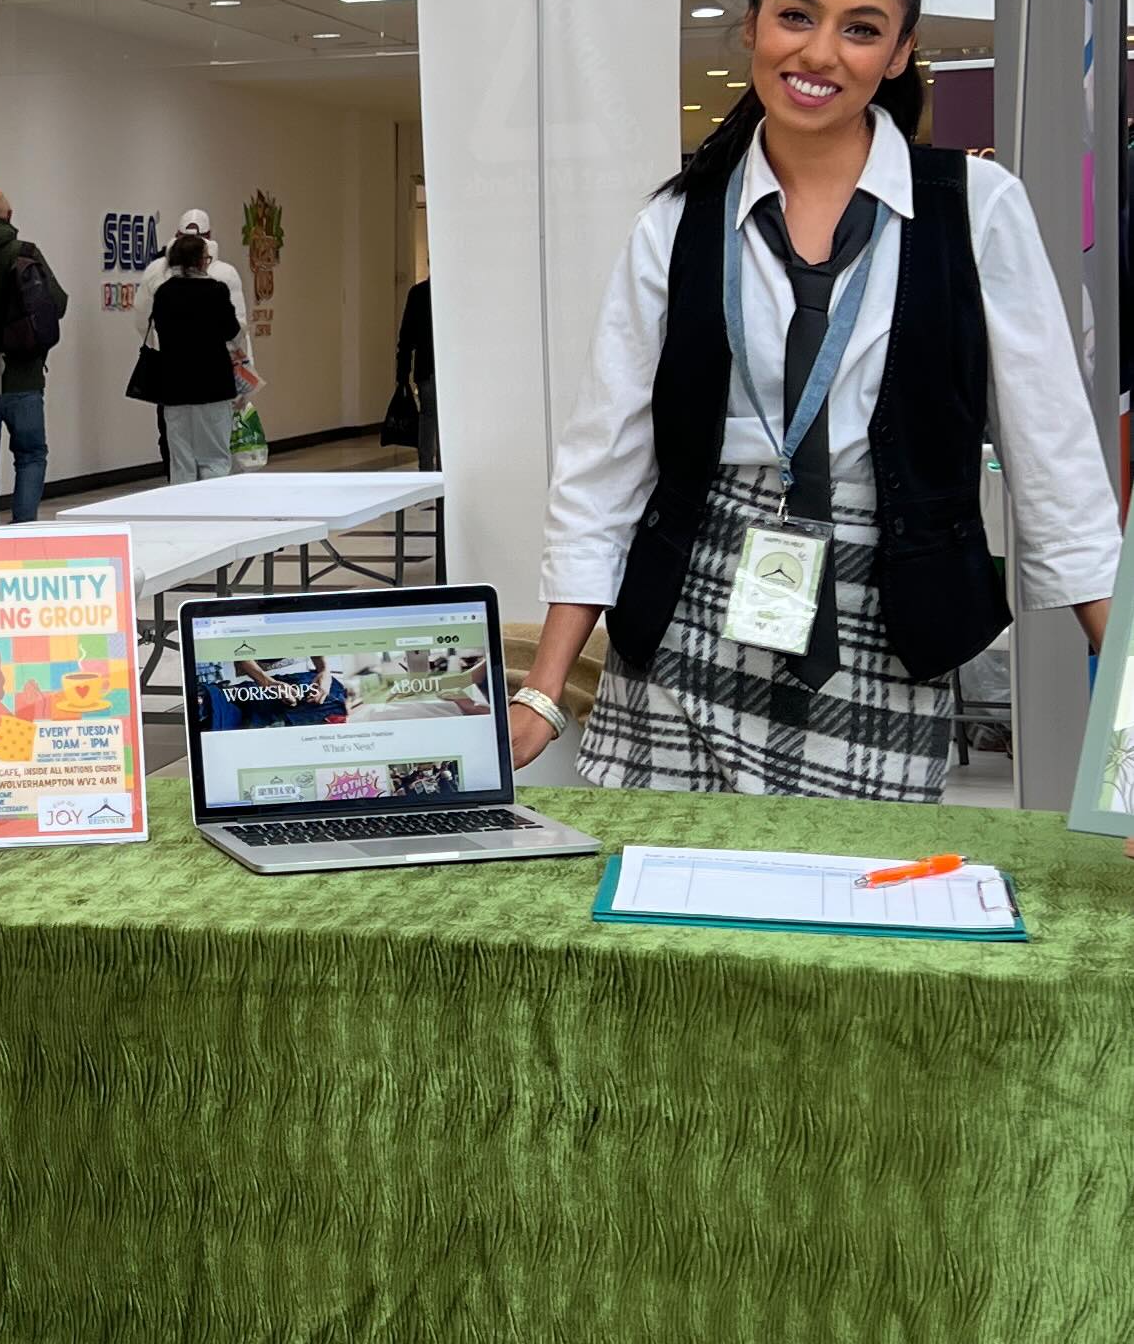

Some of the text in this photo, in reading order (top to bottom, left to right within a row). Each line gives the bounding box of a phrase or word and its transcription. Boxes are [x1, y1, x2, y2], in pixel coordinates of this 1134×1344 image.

[103, 213, 158, 270] SEGA
[39, 605, 113, 628] GROUP
[222, 683, 319, 702] WORKSHOPS
[391, 678, 442, 694] ABOUT
[39, 725, 120, 738] EVERY TUESDAY
[52, 739, 79, 749] 10AM
[90, 738, 110, 748] 1PM
[23, 767, 47, 776] INSIDE
[50, 766, 62, 774] ALL
[65, 765, 93, 774] NATIONS
[95, 764, 122, 773] CHURCH
[77, 777, 97, 786] WV2
[46, 810, 83, 826] JOY
